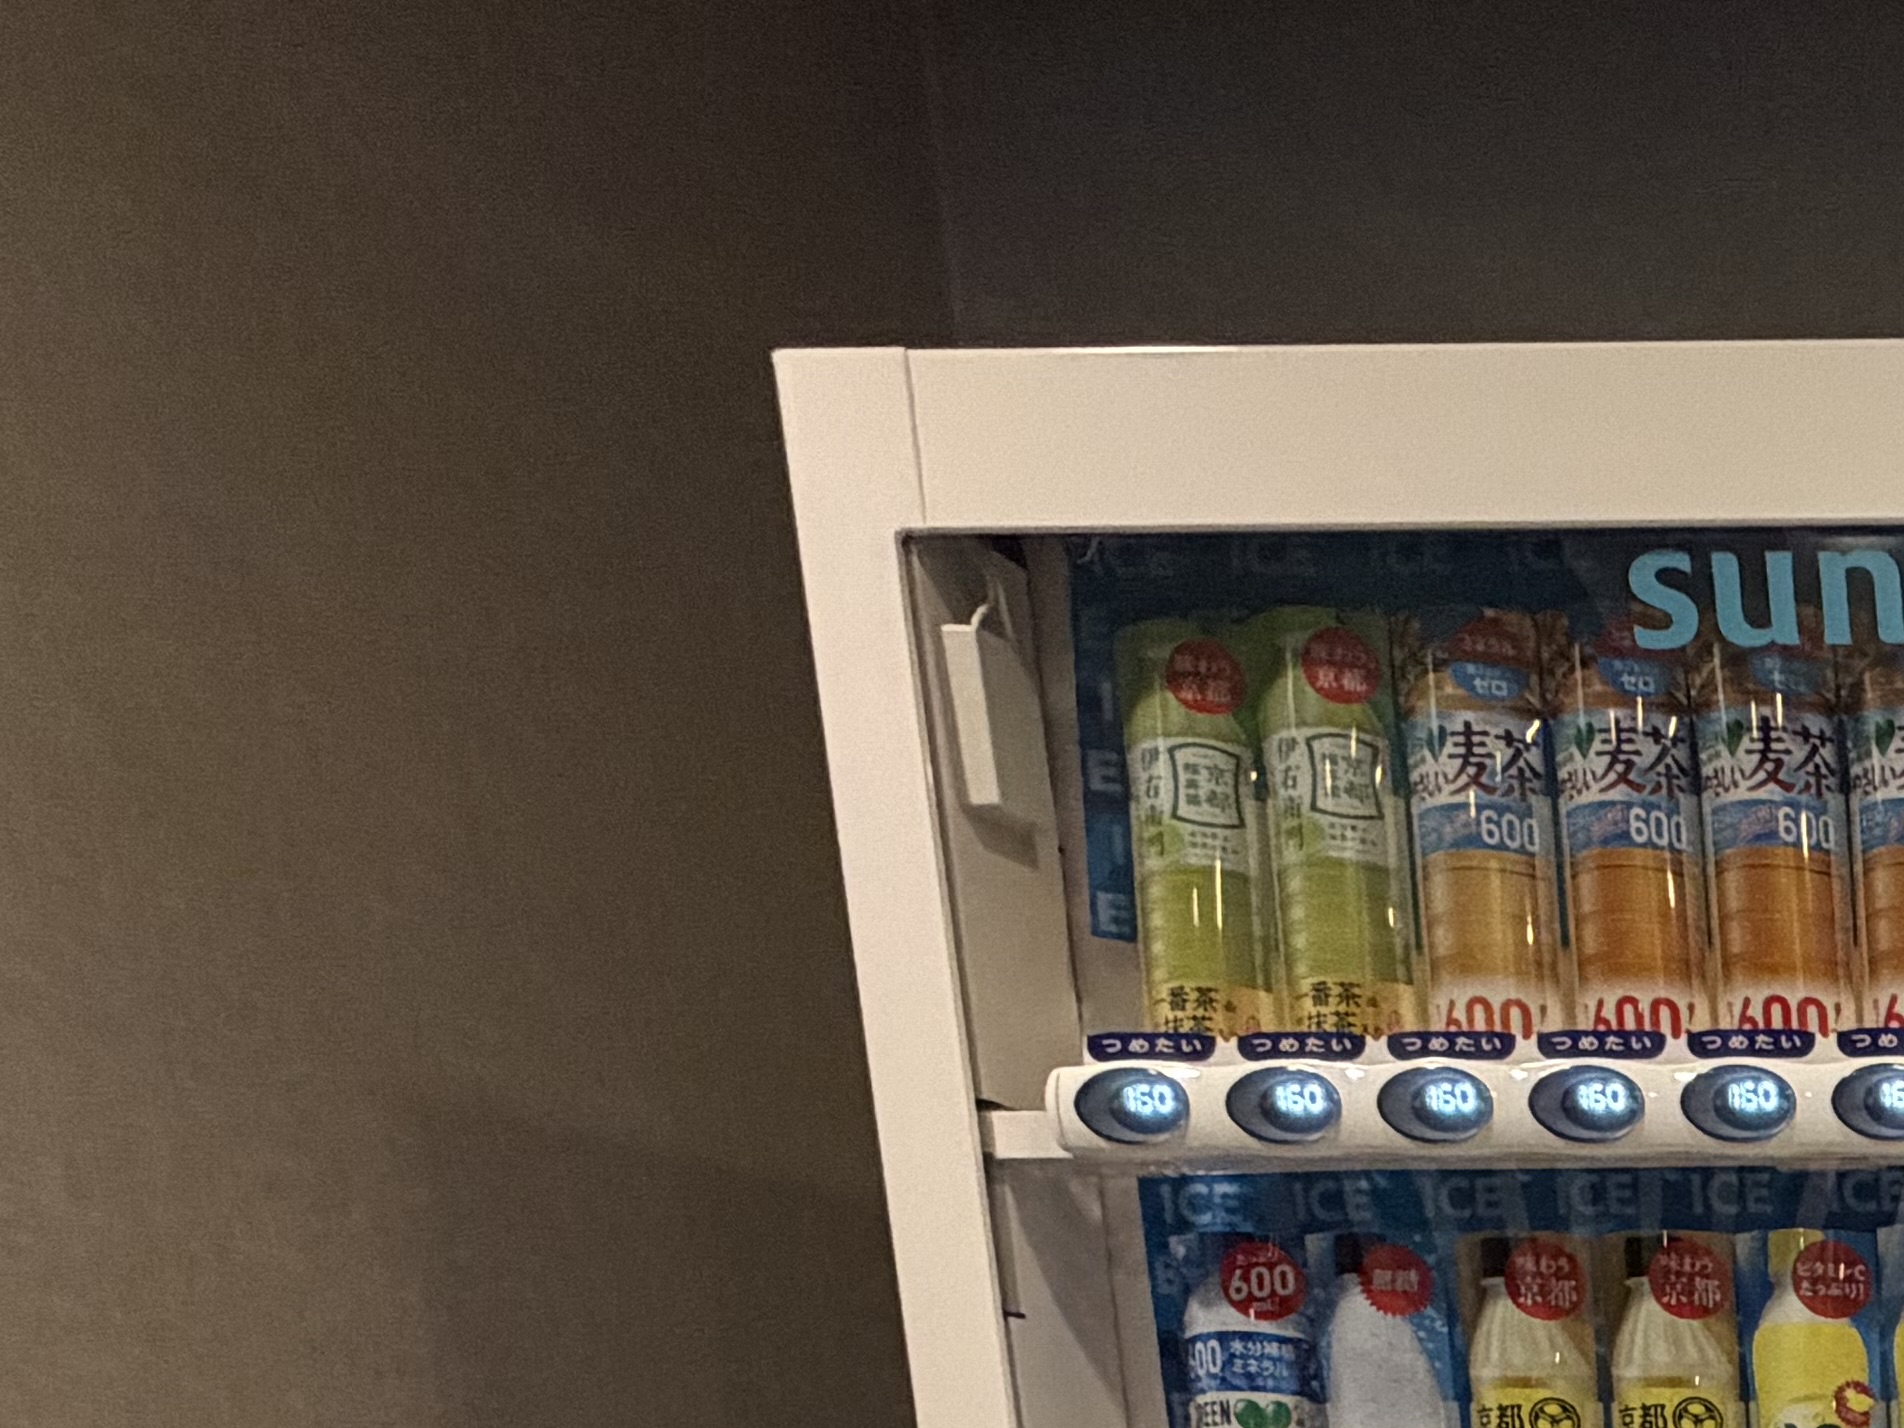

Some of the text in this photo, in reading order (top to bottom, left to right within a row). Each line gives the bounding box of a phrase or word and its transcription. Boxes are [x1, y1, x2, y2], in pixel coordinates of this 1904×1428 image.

[1600, 717, 1694, 797] 麦茶
[1480, 810, 1540, 850] 600
[1102, 1037, 1202, 1053] つめたい
[1702, 1034, 1801, 1049] つめたい
[1229, 1263, 1296, 1300] 600
